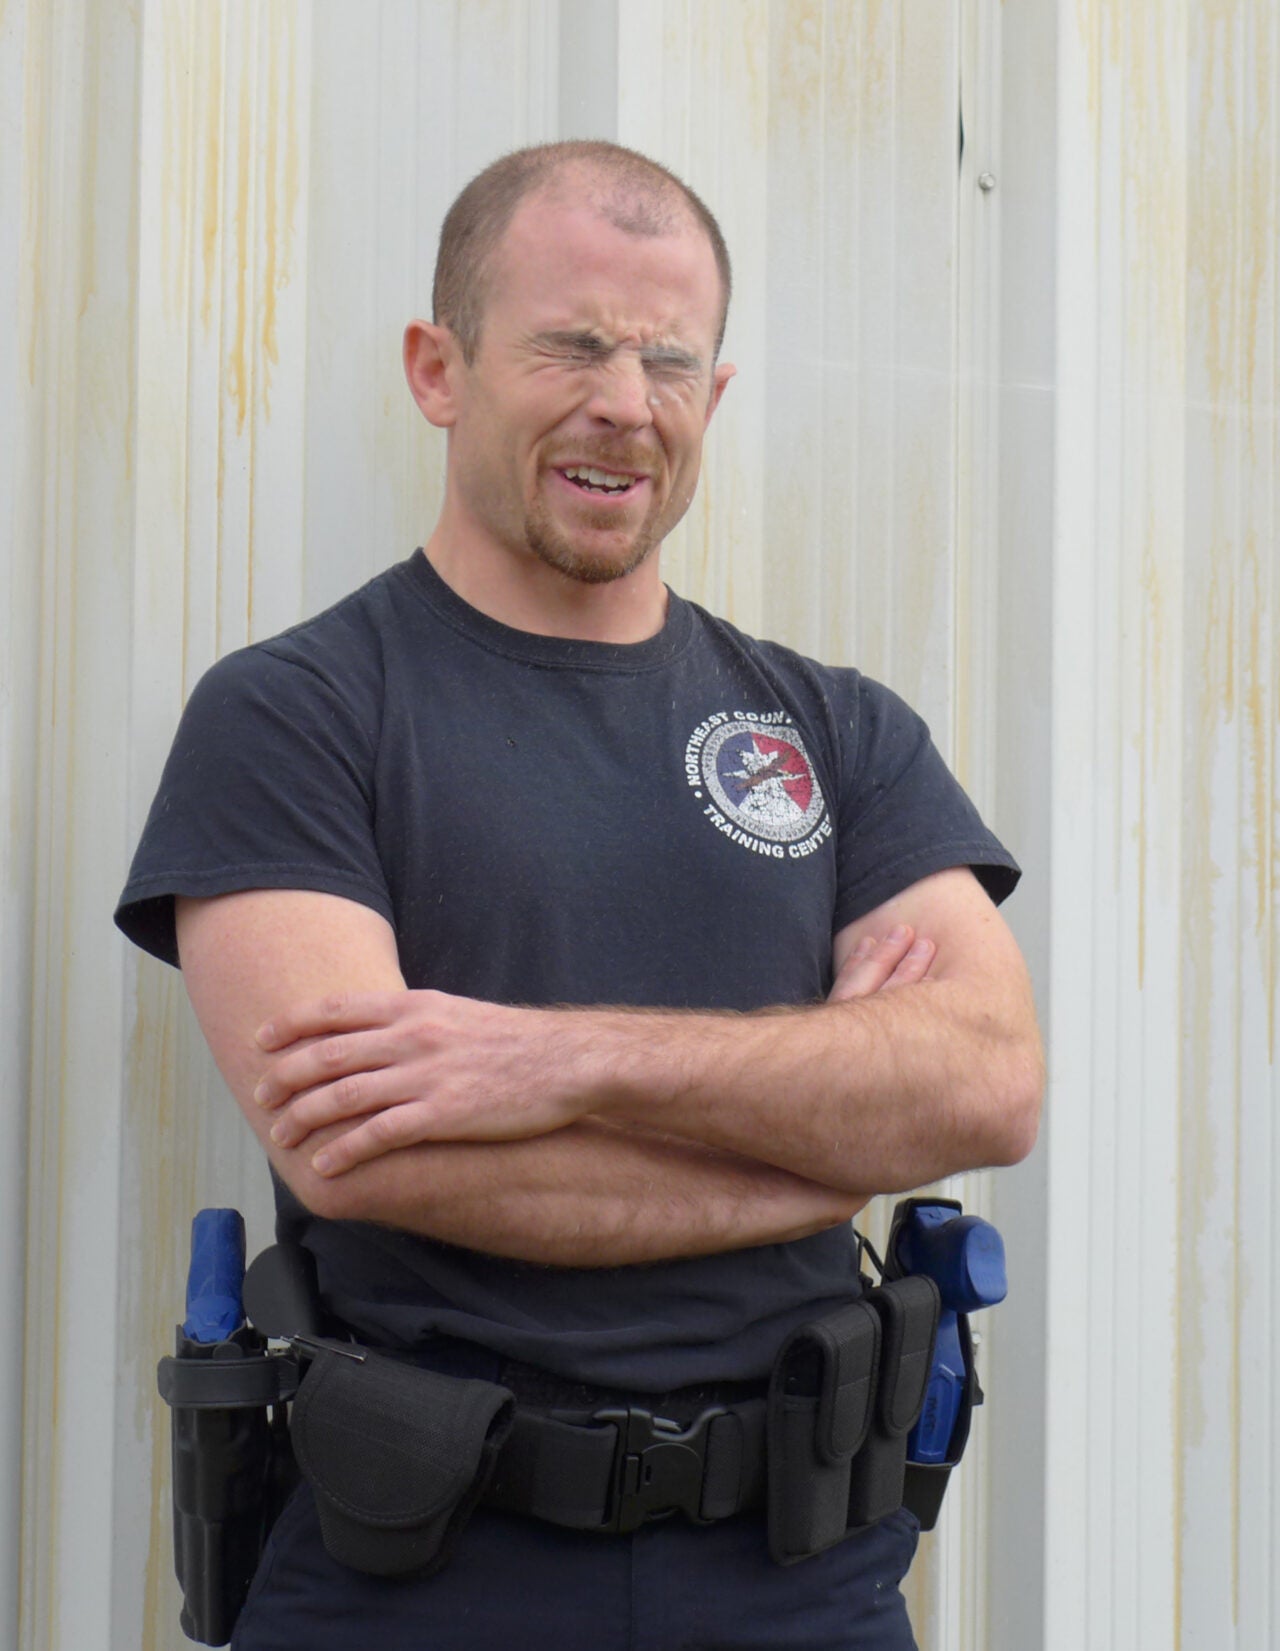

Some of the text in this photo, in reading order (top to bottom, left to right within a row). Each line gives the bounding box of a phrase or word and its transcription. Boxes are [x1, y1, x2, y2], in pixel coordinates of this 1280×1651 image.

[685, 711, 729, 786] NORTHEAST
[733, 710, 793, 725] COUN
[703, 803, 785, 859] TRAINING
